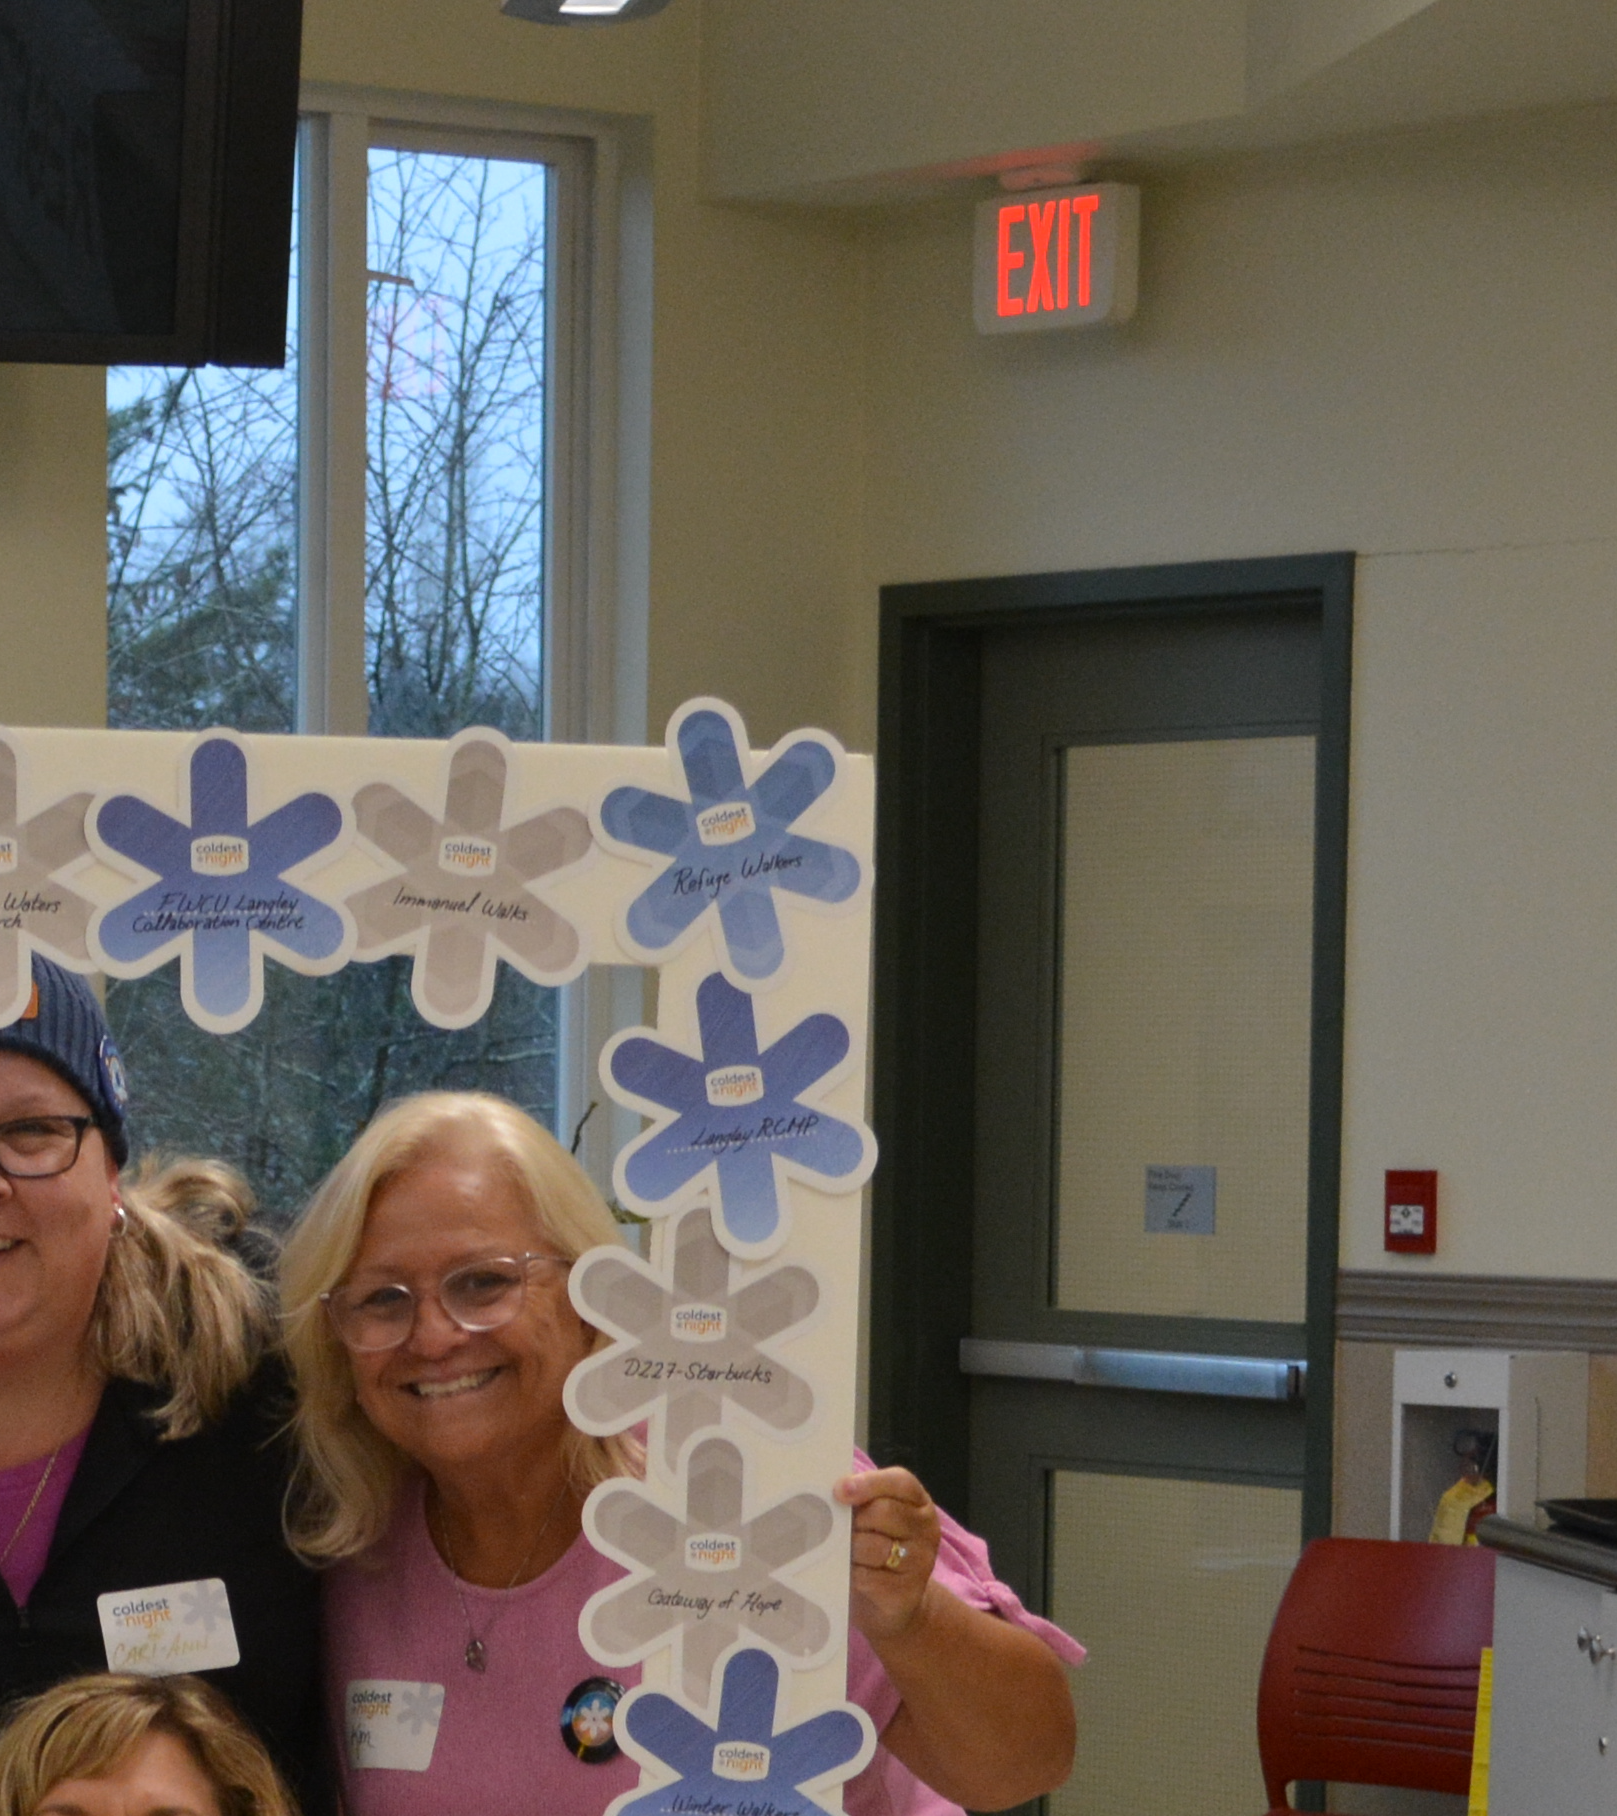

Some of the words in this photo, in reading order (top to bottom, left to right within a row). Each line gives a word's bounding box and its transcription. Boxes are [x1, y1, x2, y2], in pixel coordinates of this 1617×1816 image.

[997, 194, 1099, 317] EXIT
[701, 807, 747, 827] coldest
[711, 816, 750, 836] night
[196, 842, 243, 854] coldest
[445, 842, 491, 855] coldest
[204, 852, 244, 867] night
[452, 852, 491, 868] night
[673, 867, 731, 899] Refuge
[741, 852, 803, 879] Walkers
[3, 891, 62, 914] Waters
[235, 891, 299, 915] Langley
[394, 886, 481, 913] Immanuel
[482, 899, 529, 921] Walks
[711, 1072, 756, 1086] coldest
[720, 1081, 758, 1097] night
[757, 1114, 820, 1138] RCMP
[676, 1310, 721, 1321] coldest
[684, 1319, 721, 1335] night
[690, 1539, 736, 1550] coldest
[698, 1548, 735, 1564] night
[112, 1598, 169, 1617] coldest
[648, 1588, 714, 1620] Gateway
[125, 1609, 172, 1629] night
[352, 1690, 392, 1704] coldest
[719, 1748, 764, 1760] coldest
[726, 1757, 763, 1772] night
[672, 1794, 732, 1815] Winter
